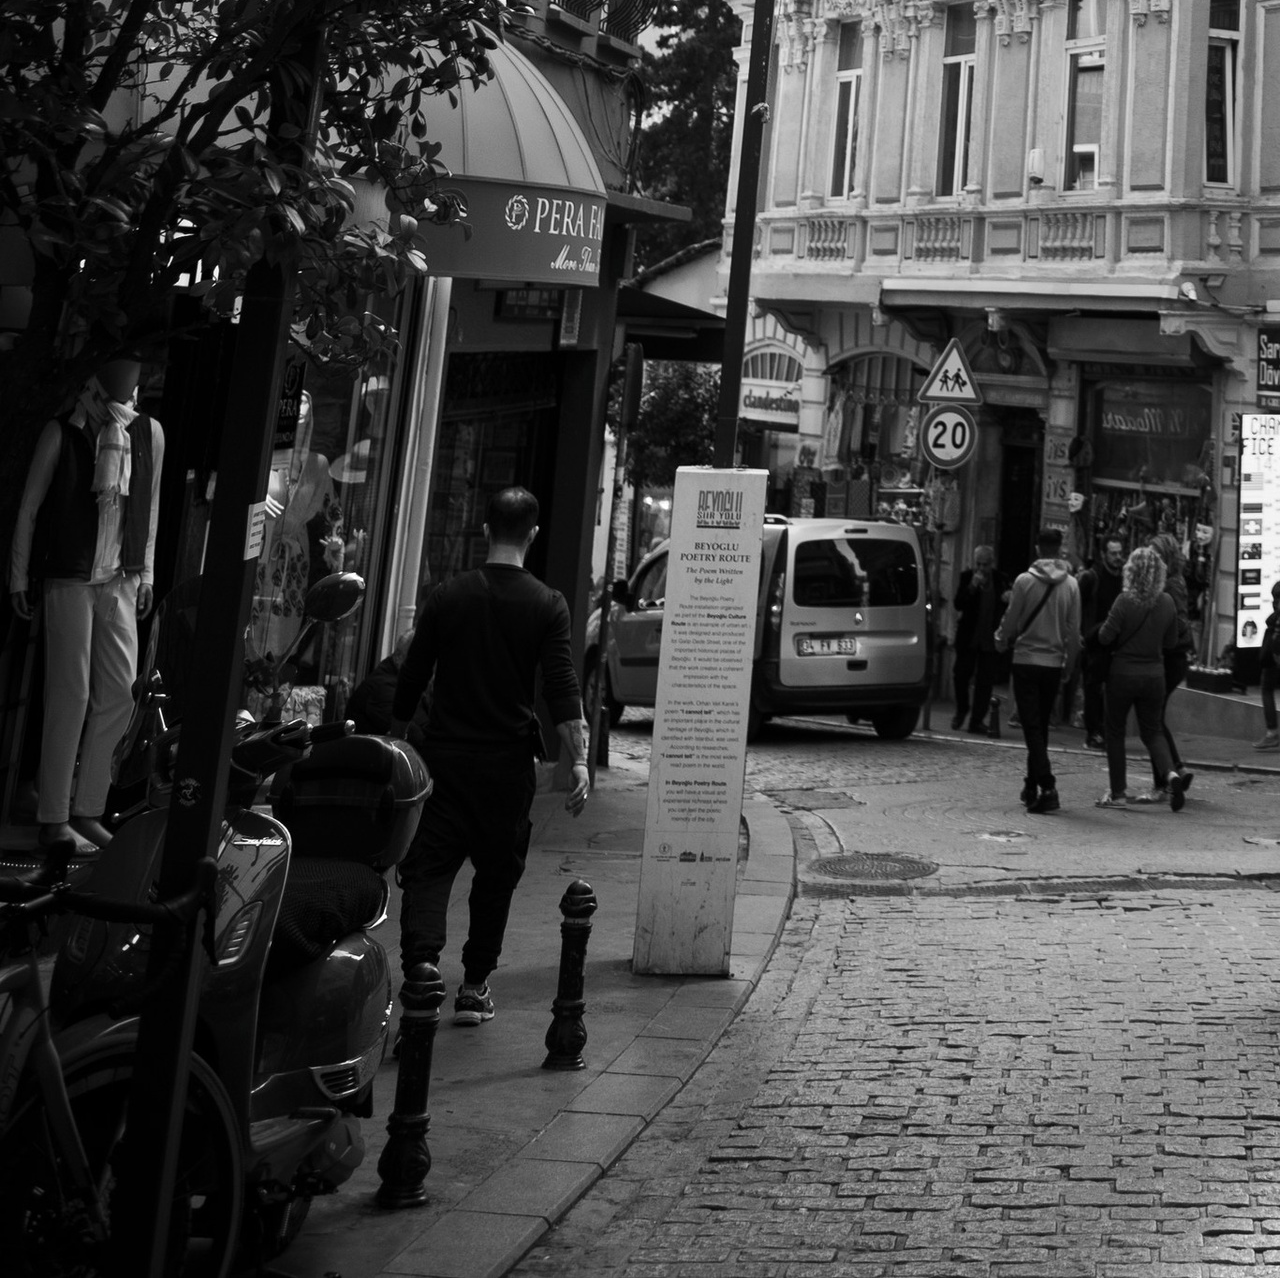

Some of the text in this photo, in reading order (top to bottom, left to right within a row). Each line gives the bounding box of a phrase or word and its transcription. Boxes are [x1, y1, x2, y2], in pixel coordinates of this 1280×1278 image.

[534, 197, 585, 238] PERA
[588, 204, 605, 241] FA
[550, 244, 578, 270] More
[931, 420, 967, 450] 20
[680, 553, 752, 563] POETRY ROUTE
[694, 577, 703, 585] by
[716, 577, 734, 585] Light
